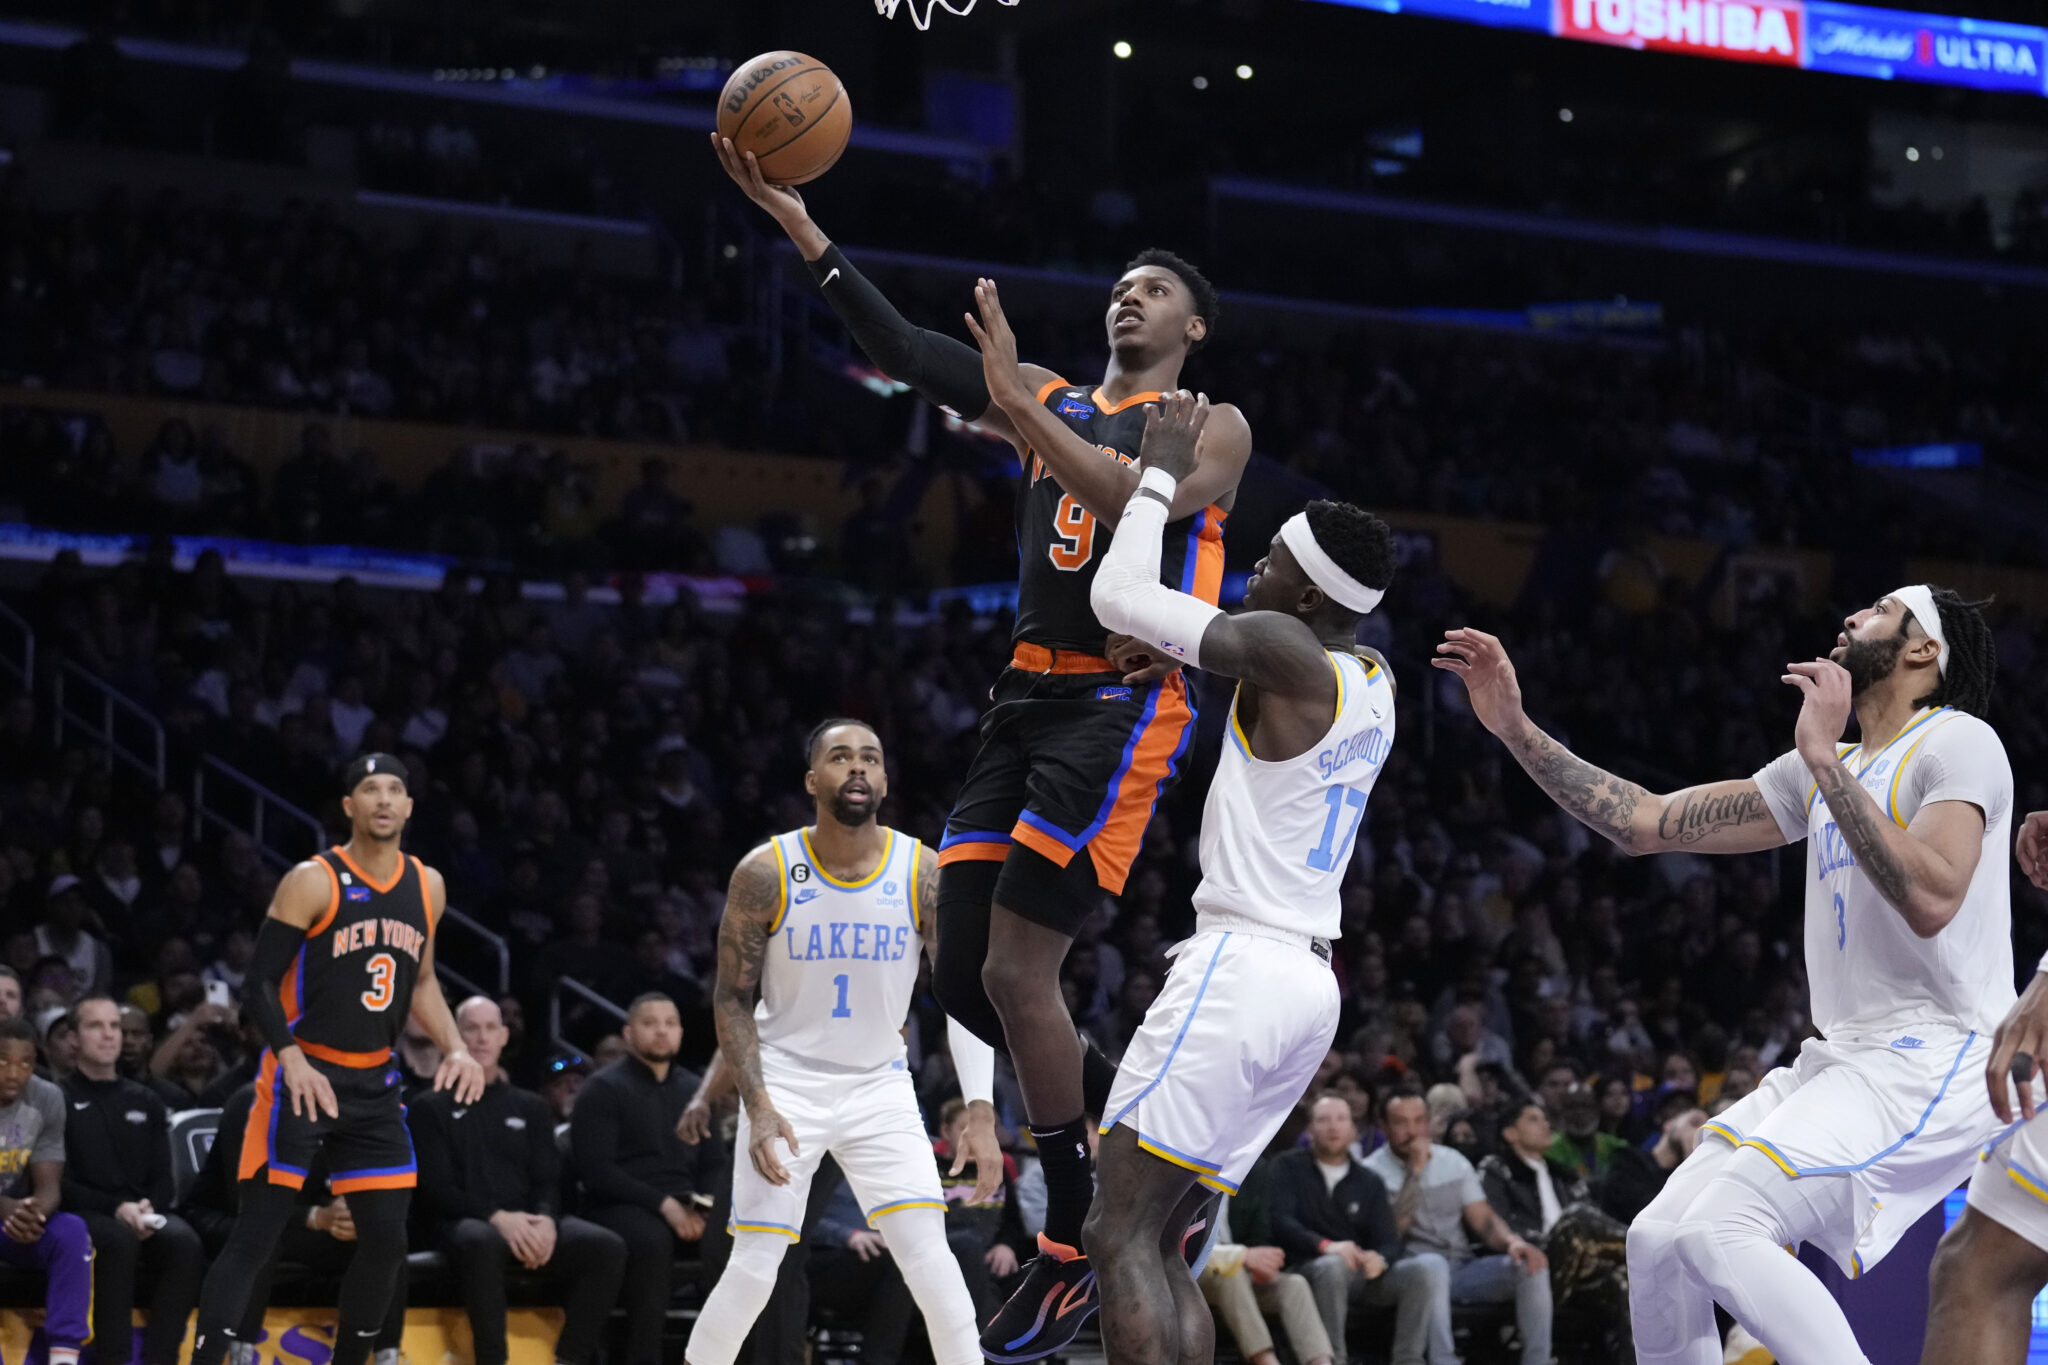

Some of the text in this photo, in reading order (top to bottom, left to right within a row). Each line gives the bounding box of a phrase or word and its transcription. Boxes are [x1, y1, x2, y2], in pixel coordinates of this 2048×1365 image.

[1570, 0, 1795, 56] TOSHIBA
[1935, 34, 2038, 77] ULTRA
[725, 56, 805, 114] Wilson
[1049, 493, 1096, 572] 9
[1305, 783, 1368, 873] 17
[1658, 790, 1762, 840] Chicago
[794, 865, 807, 881] 6
[332, 917, 425, 963] NEW YORK
[786, 922, 910, 961] LAKERS
[1834, 892, 1846, 951] 3
[361, 953, 397, 1012] 3
[831, 974, 852, 1018] 1
